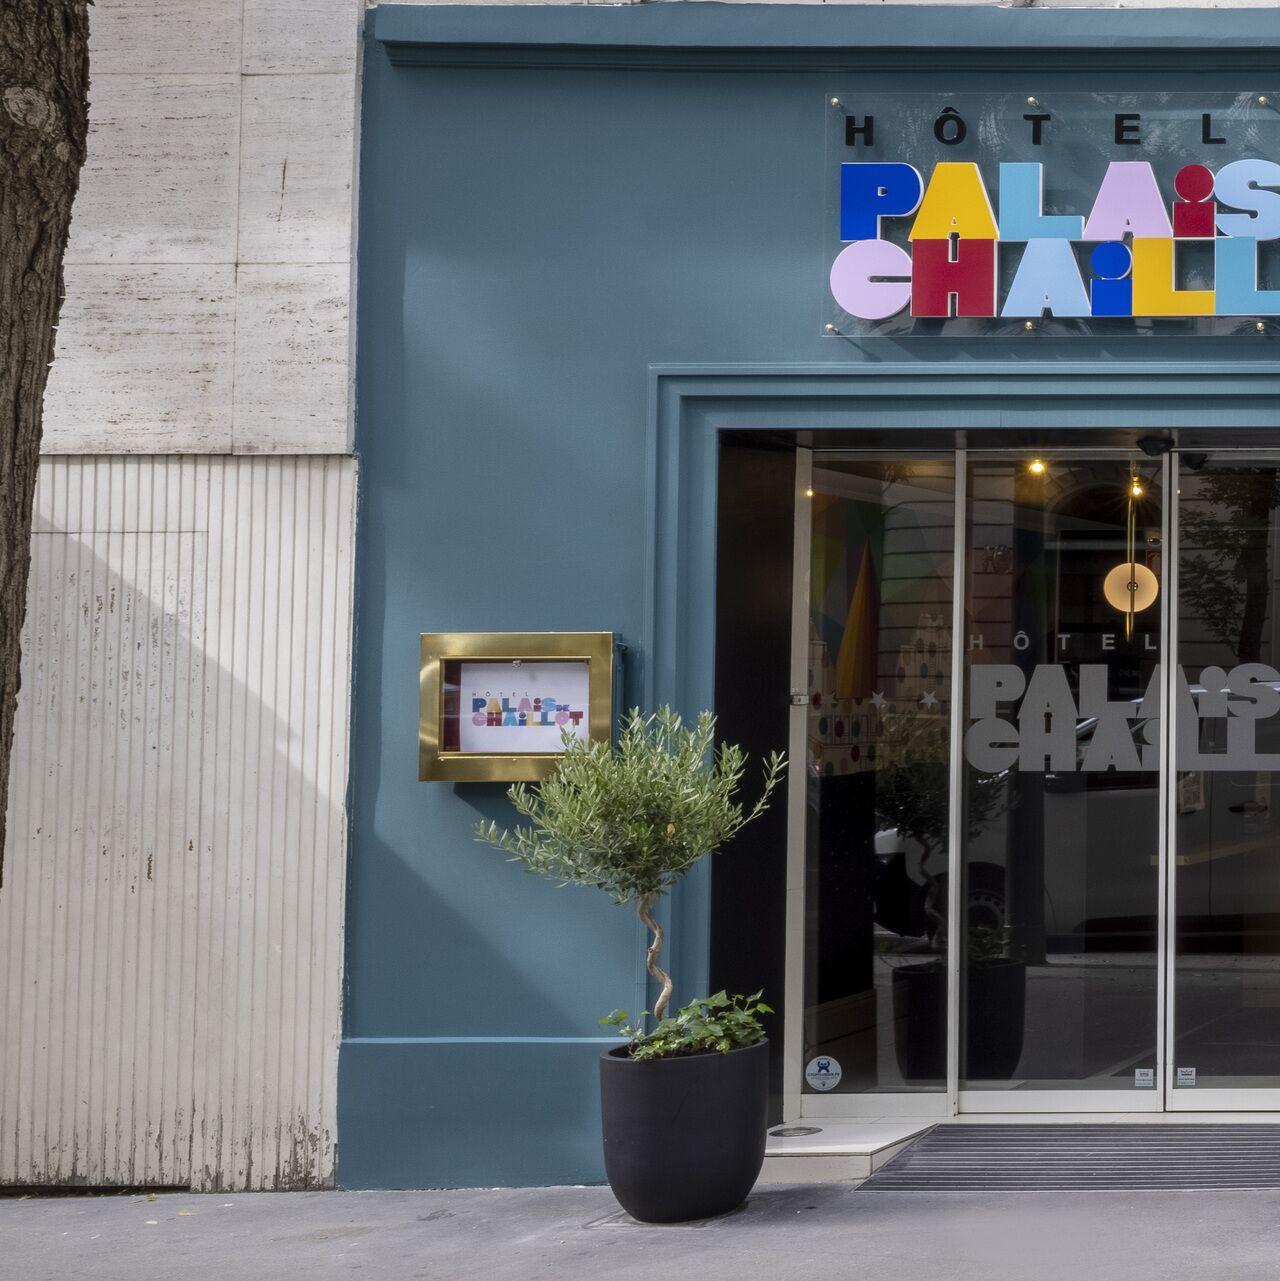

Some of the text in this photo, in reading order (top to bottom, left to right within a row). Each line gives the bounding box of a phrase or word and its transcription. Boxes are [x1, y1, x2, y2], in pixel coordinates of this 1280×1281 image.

[844, 106, 1227, 147] HÔTEL
[968, 629, 1158, 651] HÔTEL
[472, 690, 529, 698] HÔTEL
[556, 704, 570, 712] DE
